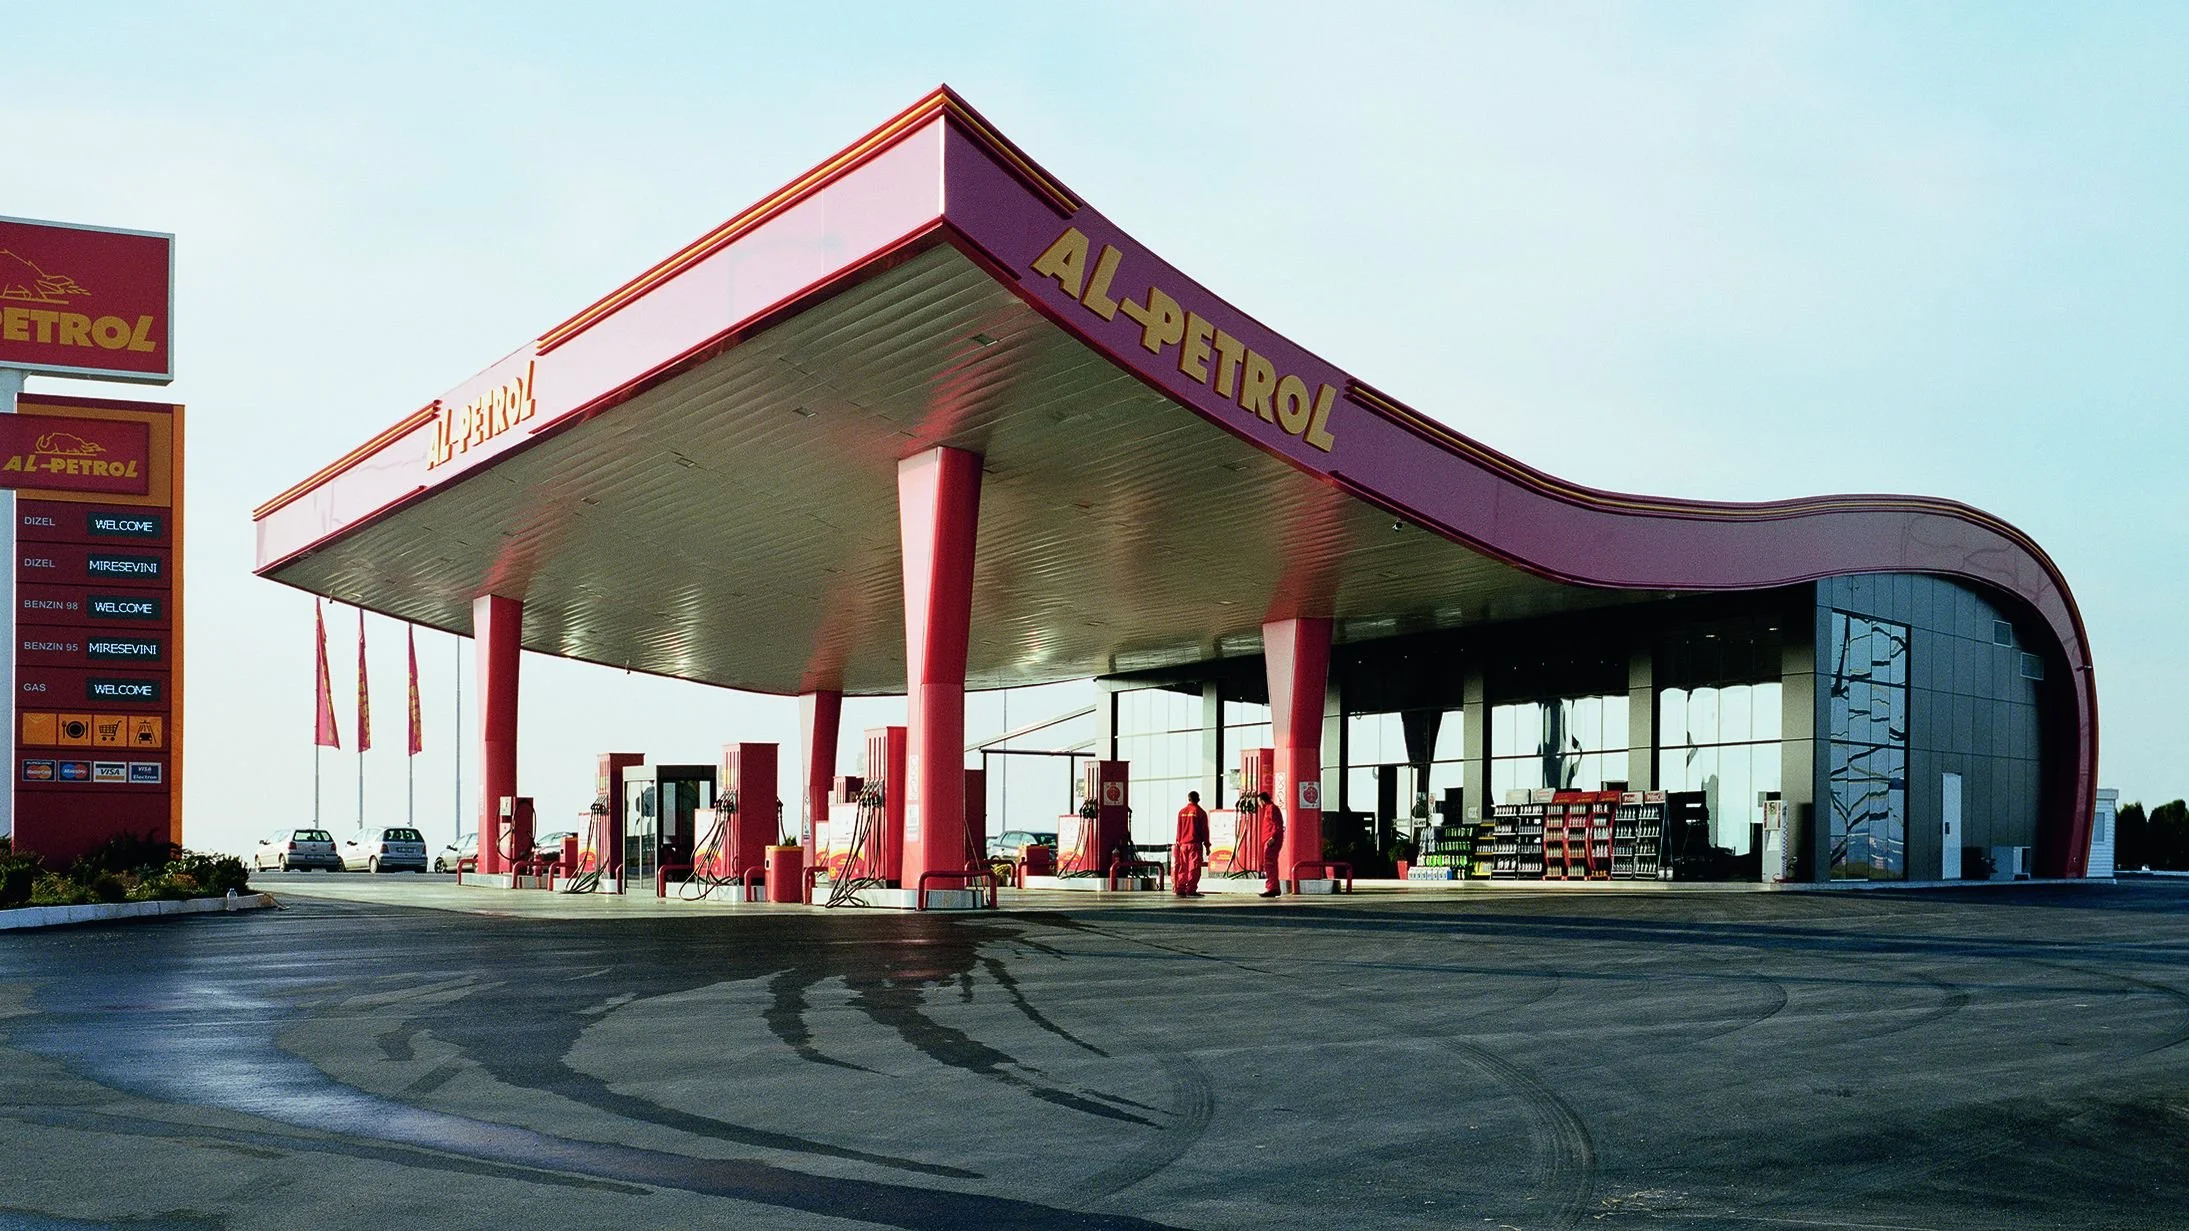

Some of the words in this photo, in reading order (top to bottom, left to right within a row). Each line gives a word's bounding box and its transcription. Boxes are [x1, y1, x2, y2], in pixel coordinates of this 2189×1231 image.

[0, 306, 156, 353] ETROL
[1029, 226, 1337, 453] AL-PETROL
[3, 454, 138, 478] AL-PETROL
[24, 516, 56, 526] DIZEL
[95, 519, 153, 532] WELCOME
[24, 558, 56, 568] DIZEL
[89, 560, 157, 573] MIRESEVINI
[24, 600, 63, 609] BENZIN
[66, 602, 79, 610] 98
[95, 601, 152, 614] WELCOME
[24, 642, 63, 651] BENZIN
[88, 643, 157, 655] MIRESEVINI
[23, 683, 47, 692] GAS
[94, 684, 152, 696] WELCOME
[100, 768, 120, 776] VISA
